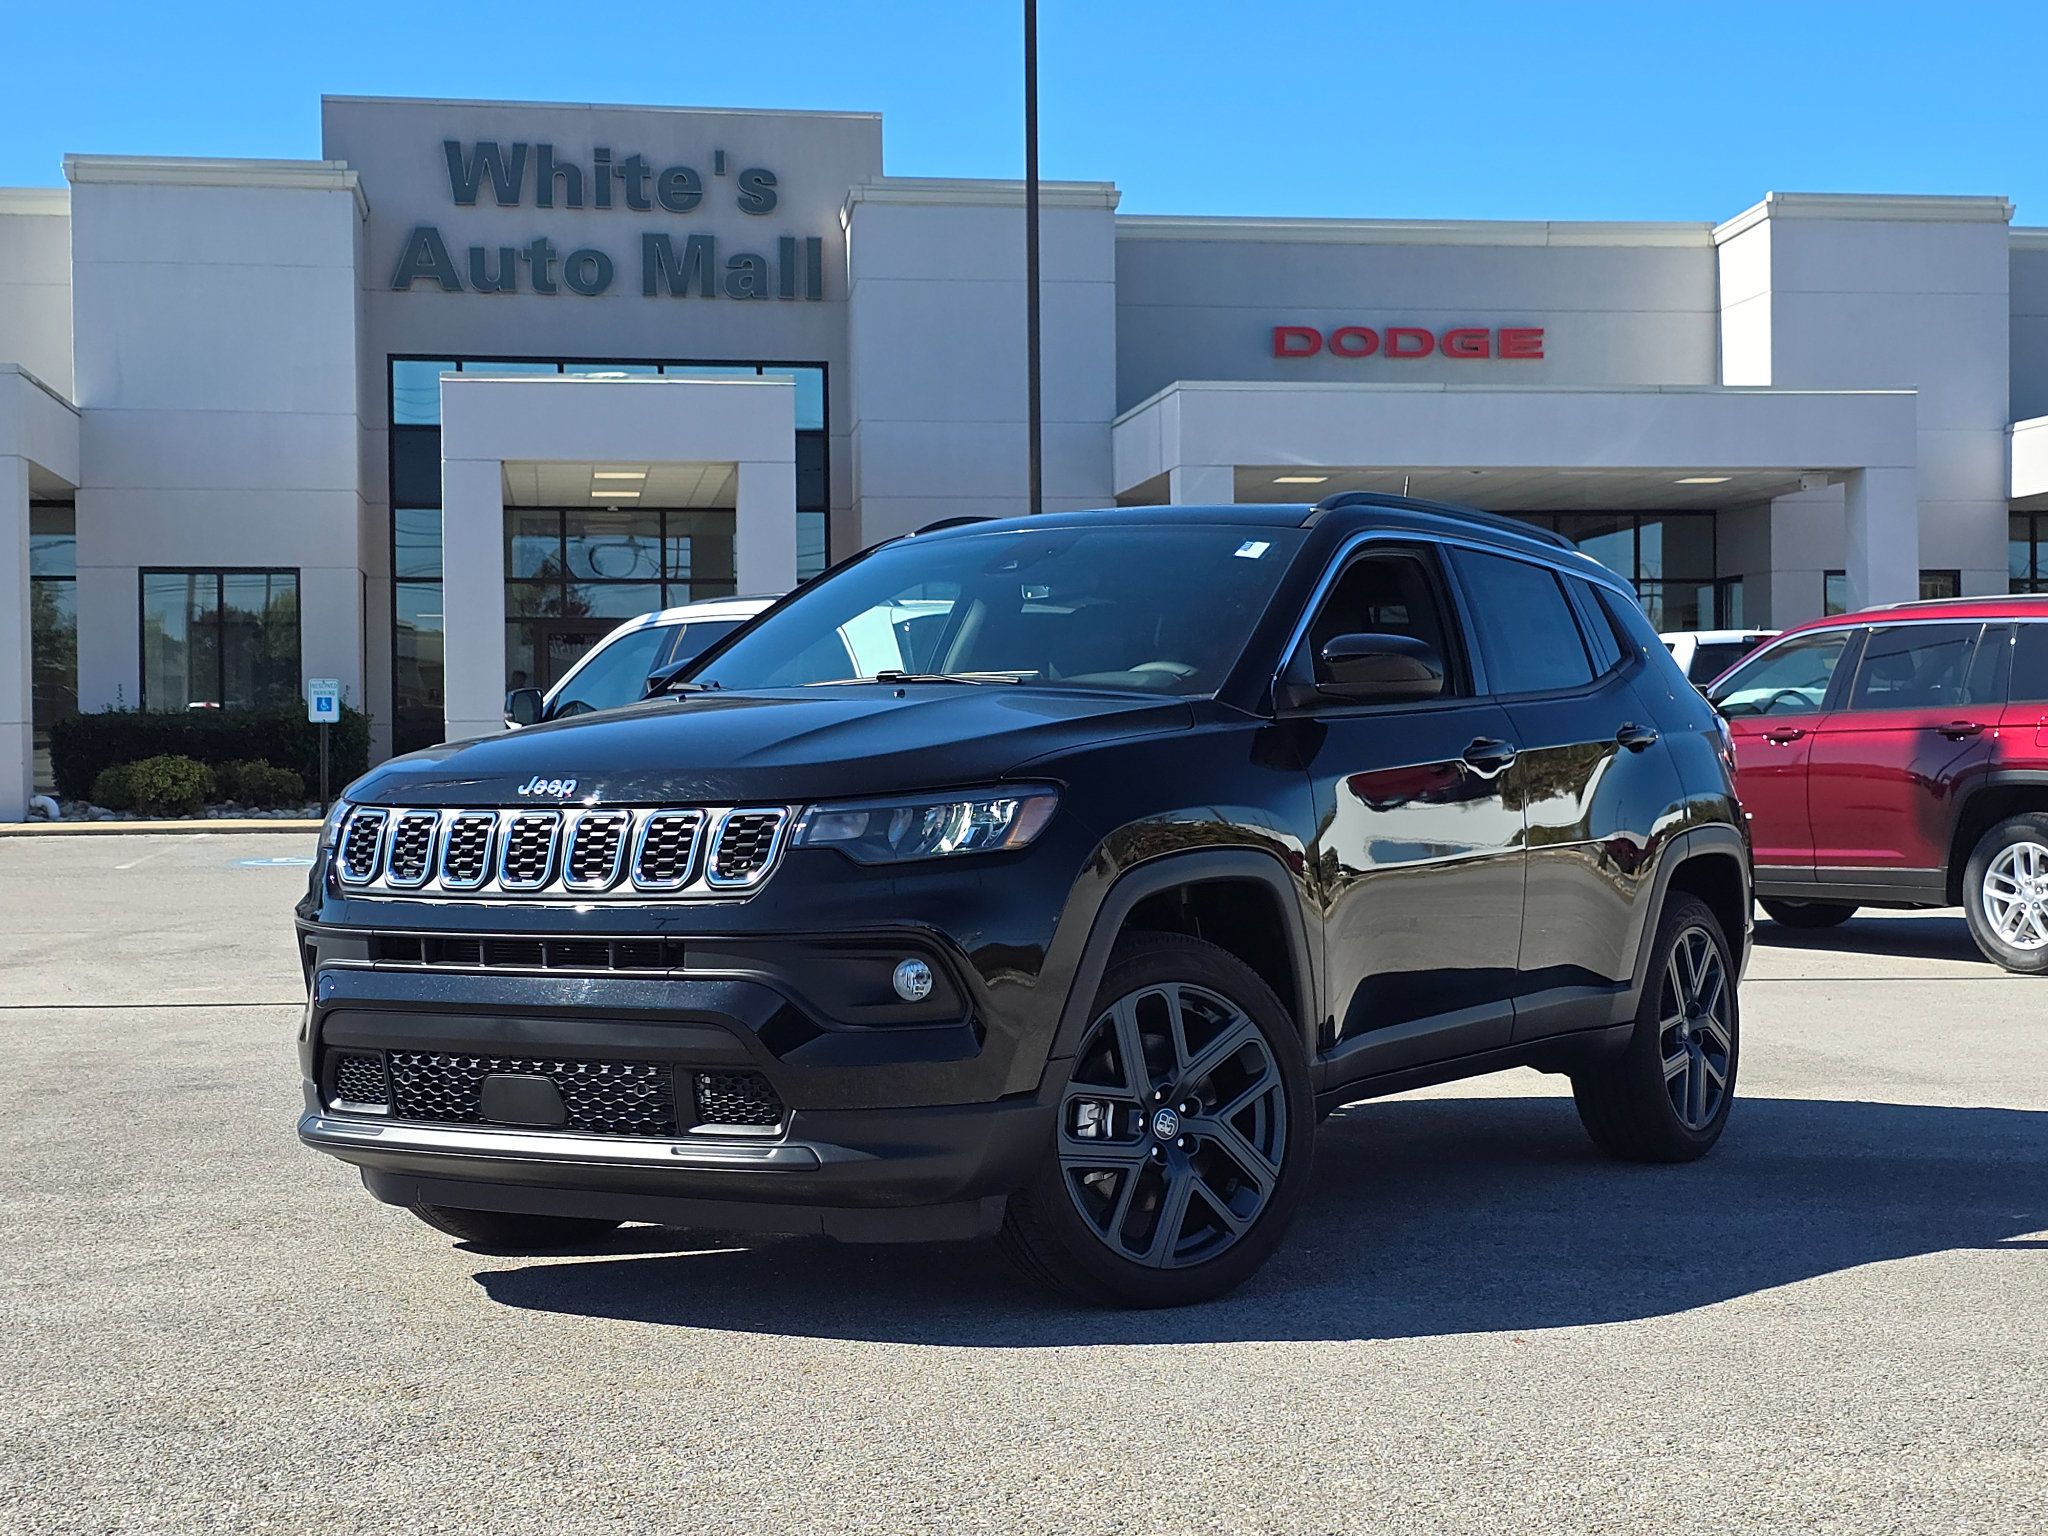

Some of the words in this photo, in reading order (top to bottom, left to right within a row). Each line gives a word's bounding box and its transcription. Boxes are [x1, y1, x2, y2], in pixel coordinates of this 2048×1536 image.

[443, 140, 779, 215] White's
[391, 226, 614, 297] Auto
[641, 232, 823, 300] Mall
[1273, 326, 1544, 359] DODGE
[518, 776, 577, 797] Jeep
